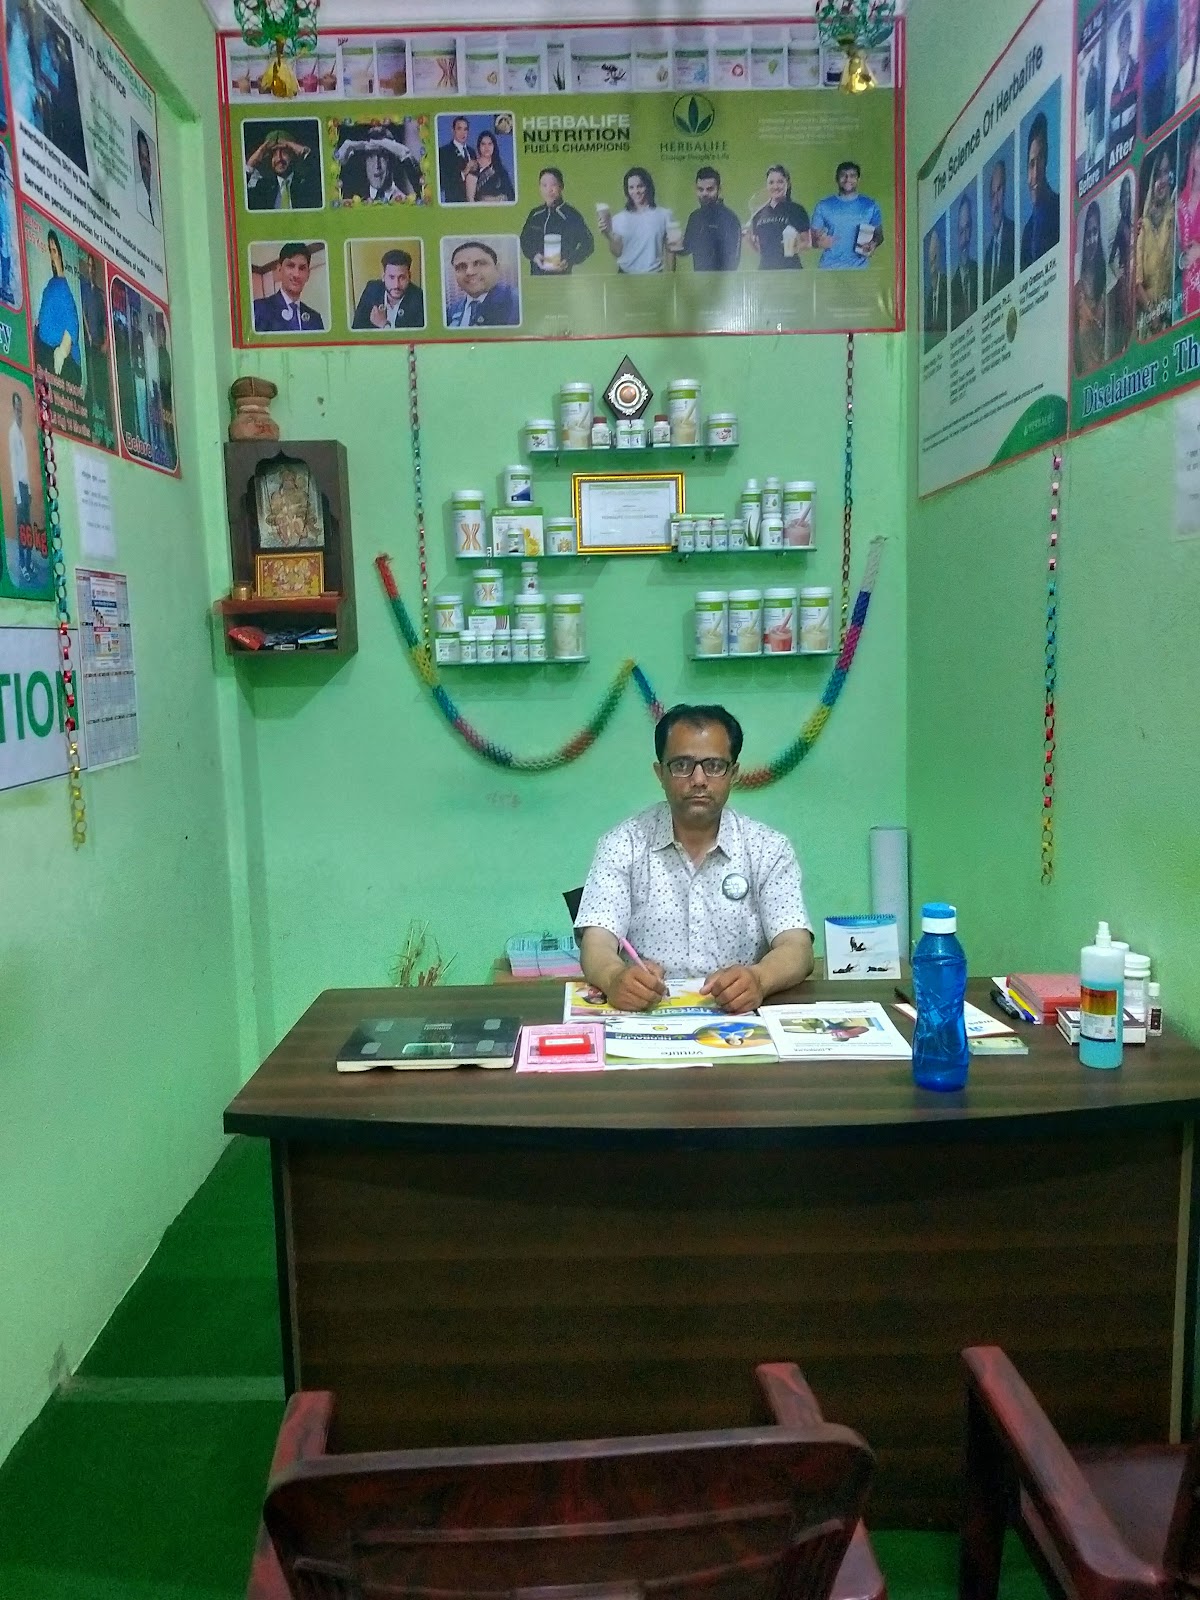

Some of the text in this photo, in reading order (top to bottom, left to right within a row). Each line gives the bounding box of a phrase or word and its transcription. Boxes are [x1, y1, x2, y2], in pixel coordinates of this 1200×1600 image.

[522, 114, 631, 130] HERBALIFE
[933, 43, 1044, 200] The Science Of Herbalife
[523, 128, 631, 143] NUTRITION
[524, 142, 631, 154] FUELS CHAMPIONS
[1108, 134, 1135, 171] After
[1078, 167, 1100, 199] Before
[1082, 360, 1159, 418] Disclaimer
[125, 431, 152, 458] Before
[18, 522, 33, 546] 66
